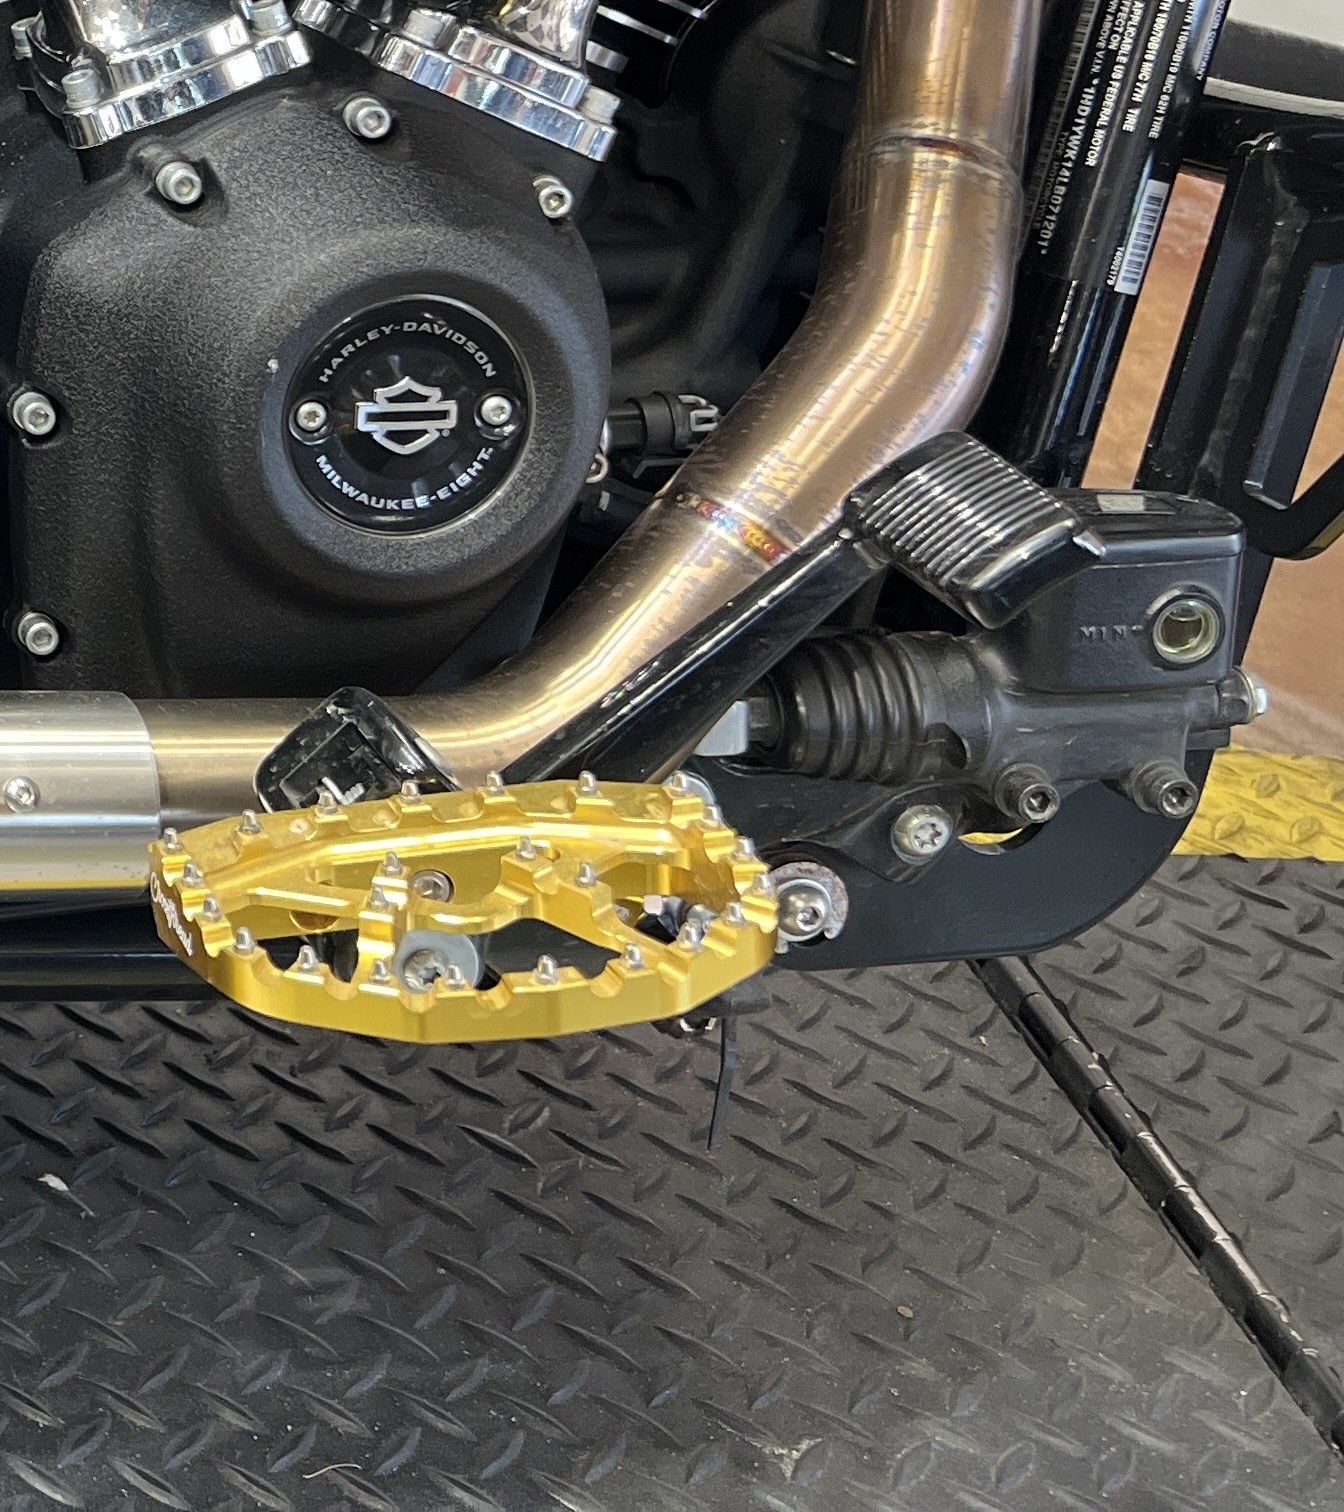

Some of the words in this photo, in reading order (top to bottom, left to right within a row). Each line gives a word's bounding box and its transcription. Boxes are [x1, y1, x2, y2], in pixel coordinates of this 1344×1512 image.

[1095, 14, 1115, 48] ABOVE
[1114, 2, 1146, 64] APPLICABLE
[1088, 50, 1106, 75] V.I.N.
[1136, 63, 1155, 81] M/C
[1195, 31, 1217, 80] COMPANY
[1130, 83, 1149, 102] 77H
[1161, 75, 1177, 93] M/C
[1095, 82, 1122, 128] FEDERAL
[1121, 107, 1142, 132] TIRE
[1147, 116, 1165, 139] TIRE
[1083, 130, 1107, 166] MOTOR
[319, 321, 496, 383] HARLEY-DAVIDSON
[315, 447, 494, 511] MILWAUKEE-EIGHT
